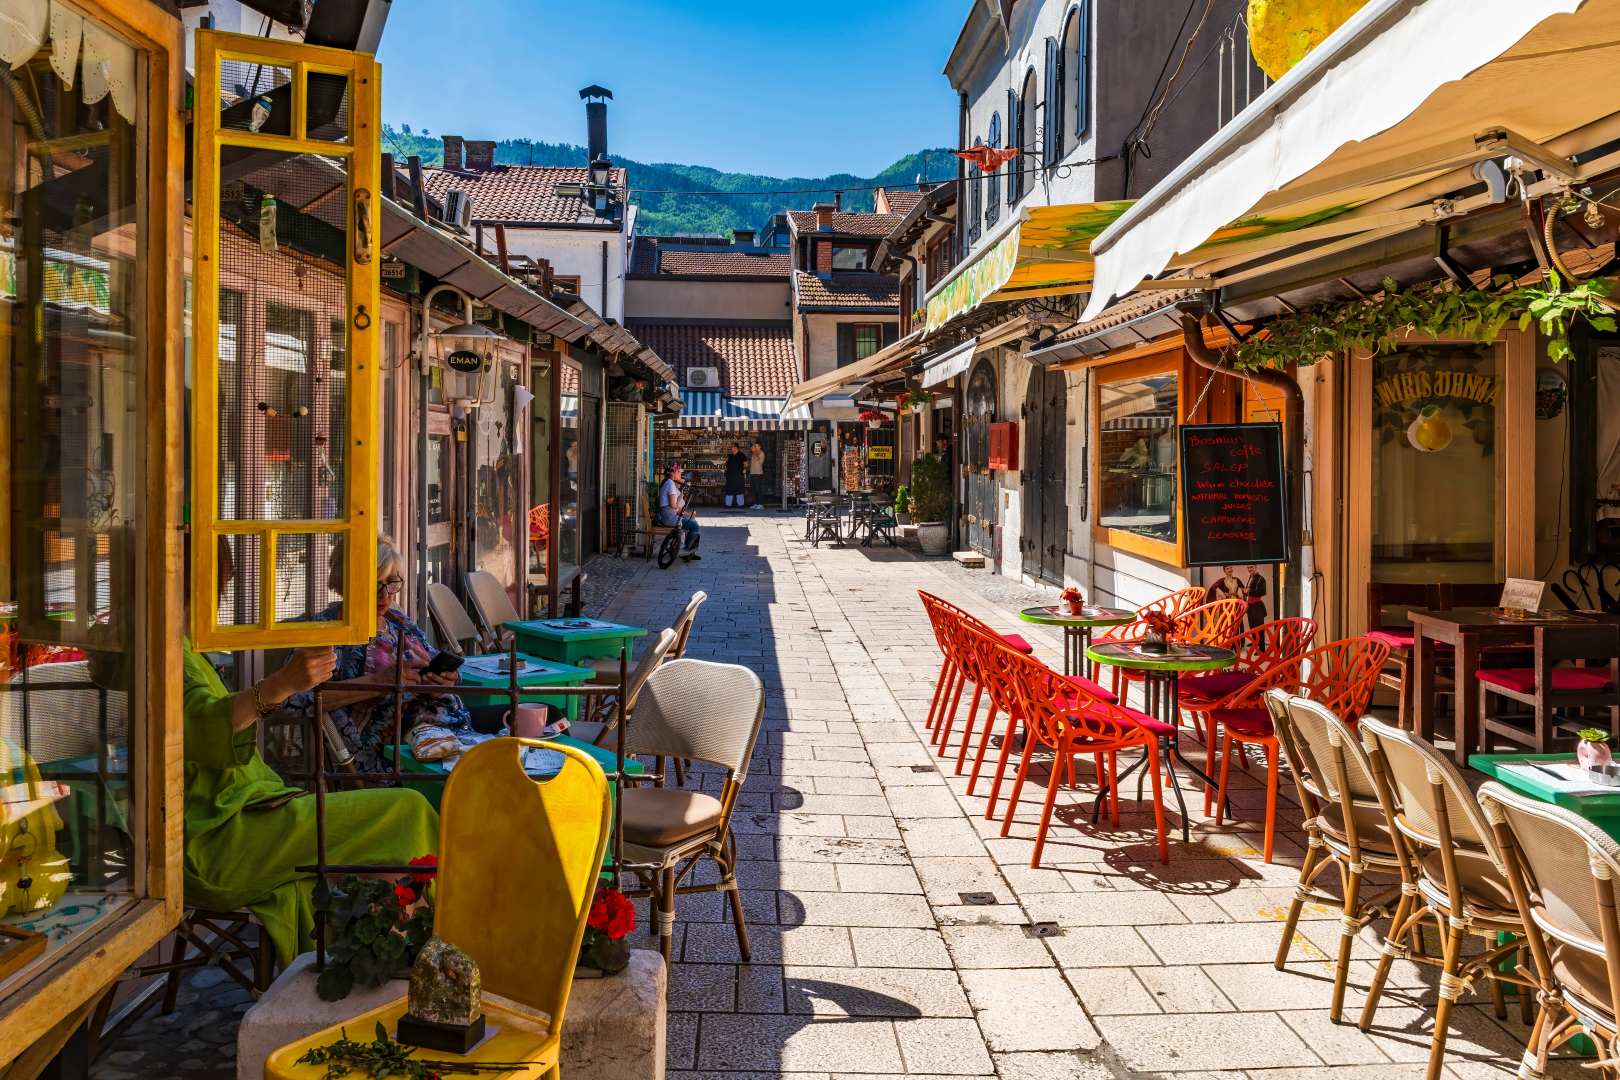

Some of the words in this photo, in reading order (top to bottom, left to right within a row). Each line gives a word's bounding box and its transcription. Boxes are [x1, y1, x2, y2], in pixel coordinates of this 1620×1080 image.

[450, 356, 478, 365] EMAN
[1188, 435, 1244, 447] Bosnian
[1229, 444, 1262, 459] coffe
[1200, 462, 1249, 474] SALEP
[1196, 480, 1225, 489] Warm
[1229, 479, 1274, 488] chocolate
[1191, 493, 1229, 502] NATURAL
[1234, 493, 1270, 502] DOMESTIC
[1201, 516, 1255, 525] CAPPUCCINO
[1207, 531, 1257, 541] LEMONADE
